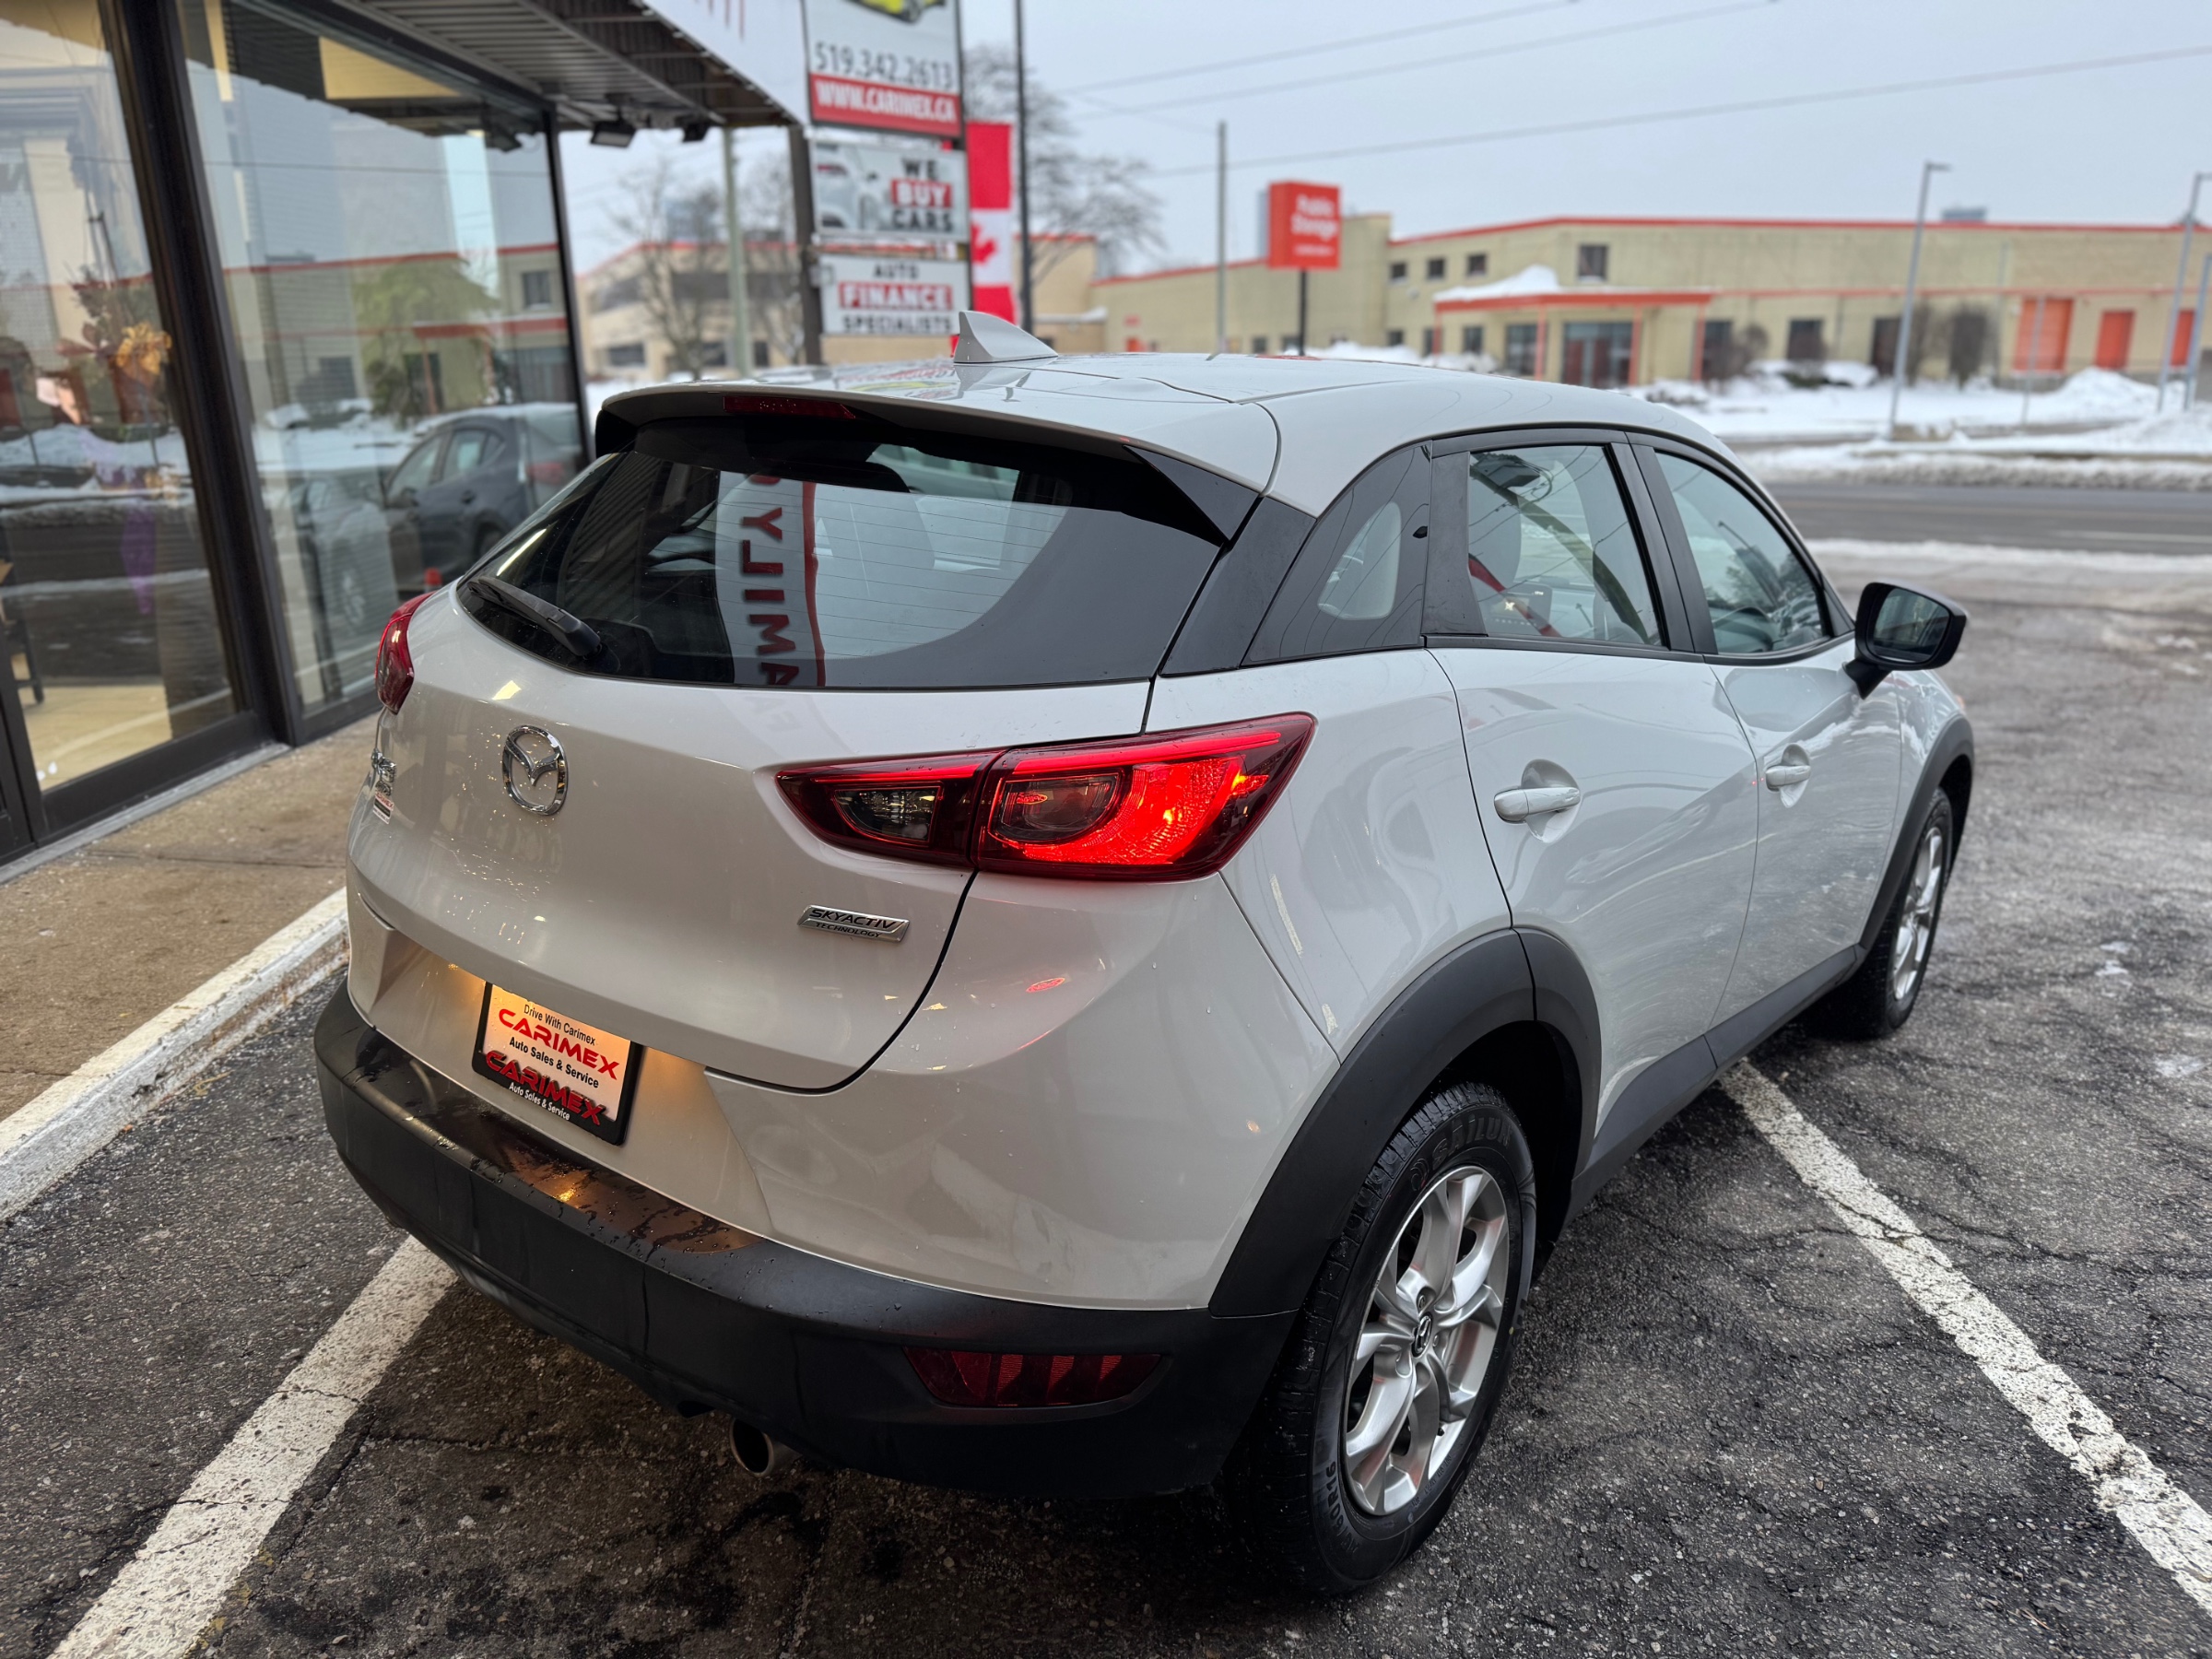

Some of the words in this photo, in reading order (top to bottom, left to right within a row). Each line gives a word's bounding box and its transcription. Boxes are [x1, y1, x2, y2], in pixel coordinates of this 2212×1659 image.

[816, 42, 954, 89] 519.342.2613
[814, 79, 957, 123] WWW.CARIMEX.CA
[902, 158, 938, 180] WE
[898, 182, 947, 206] BUY
[892, 209, 954, 232] CARS
[874, 263, 919, 279] AUTO
[843, 284, 950, 309] FINANCE
[842, 314, 952, 334] SPECIALISTS
[809, 909, 897, 929] SKYACTIV
[815, 922, 883, 938] TECHNOLOGY
[524, 1004, 543, 1020] Drive
[545, 1012, 561, 1030] With
[563, 1022, 595, 1046] Carimex
[499, 1008, 619, 1080] CARIMEX
[510, 1036, 528, 1053] Auto
[530, 1046, 554, 1066] Sales
[556, 1059, 562, 1071] &
[565, 1064, 599, 1088] Service
[486, 1050, 604, 1125] CARIMEX
[509, 1082, 524, 1096] Auto
[524, 1089, 541, 1105] Sales
[541, 1099, 547, 1109] &
[548, 1103, 570, 1121] Service
[1432, 1115, 1511, 1171] SAILUN
